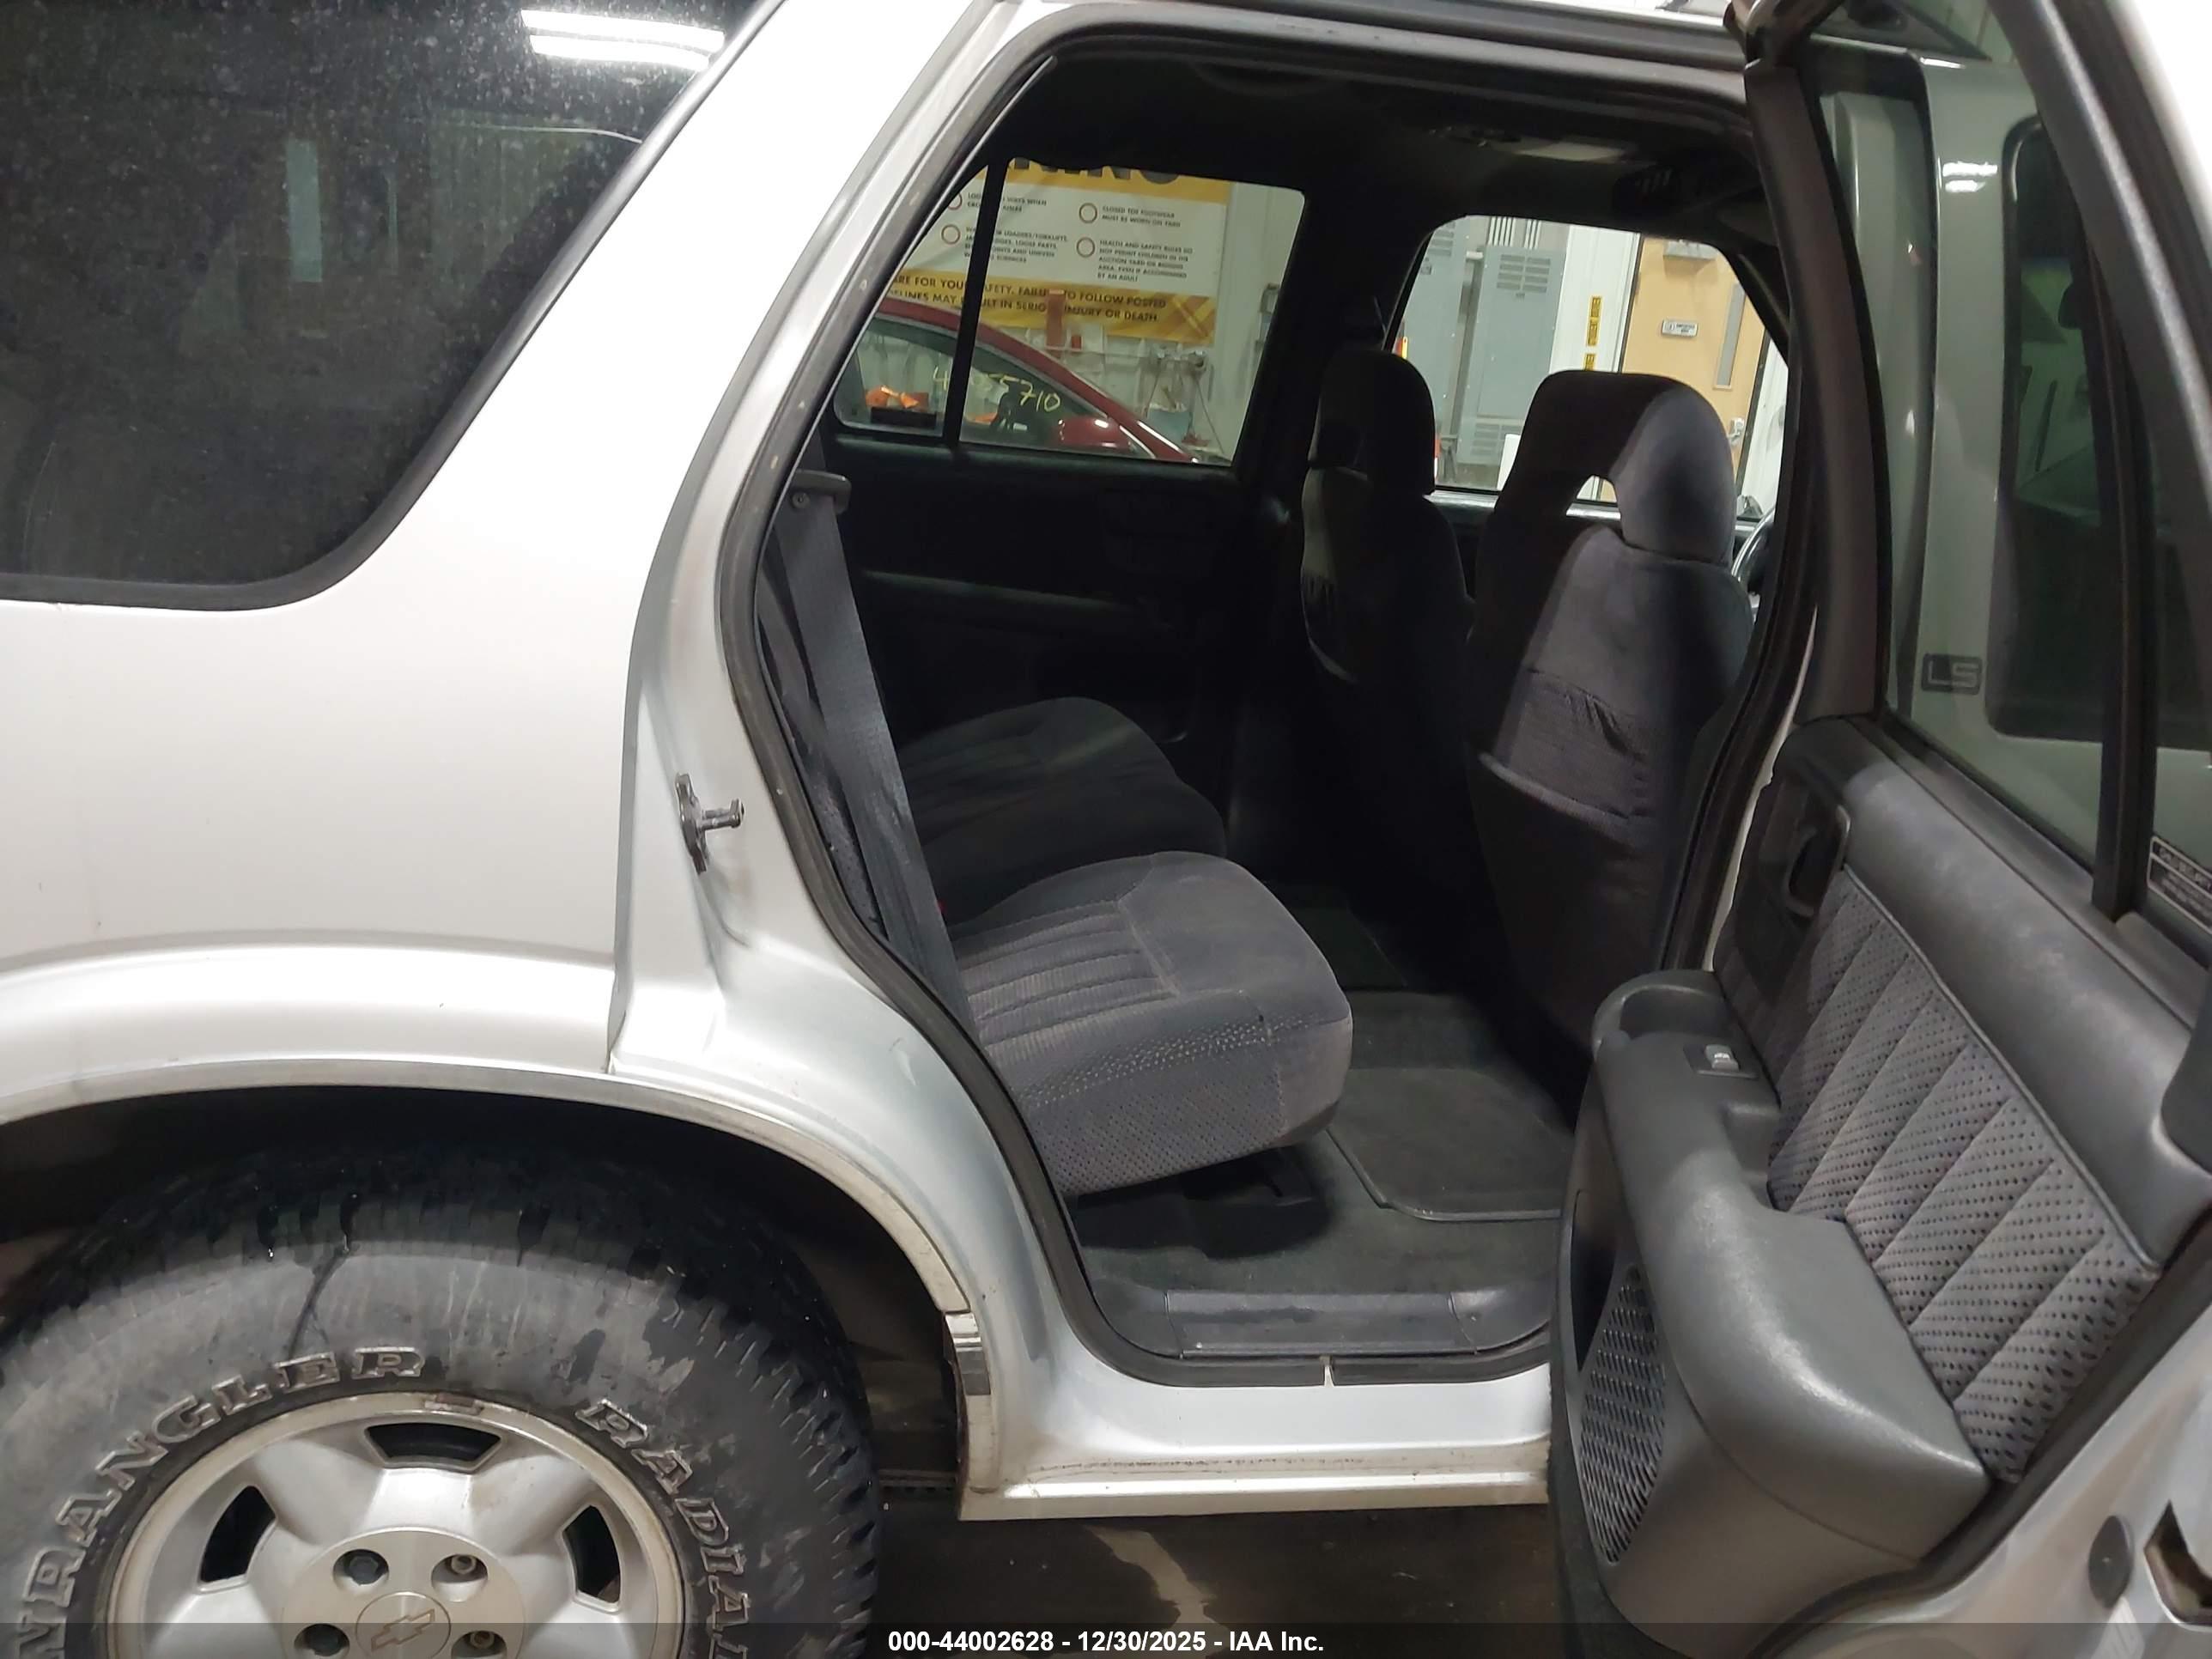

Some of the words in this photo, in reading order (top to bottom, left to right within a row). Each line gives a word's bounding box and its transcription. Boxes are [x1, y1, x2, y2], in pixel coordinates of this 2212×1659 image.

[1102, 205, 1126, 214] CLOSED
[915, 276, 936, 288] FOR
[941, 278, 964, 290] YOU
[1018, 286, 1046, 297] FAILU
[1064, 289, 1077, 300] TO
[1079, 290, 1124, 304] FOLLOW
[1126, 295, 1167, 309] POSTED
[932, 293, 957, 305] MAY
[1000, 300, 1012, 309] IN
[1016, 301, 1047, 313] SERIO
[1064, 305, 1102, 317] INJURY
[1104, 308, 1121, 319] OR
[1124, 310, 1158, 322] DEATH
[1928, 659, 1979, 689] LS
